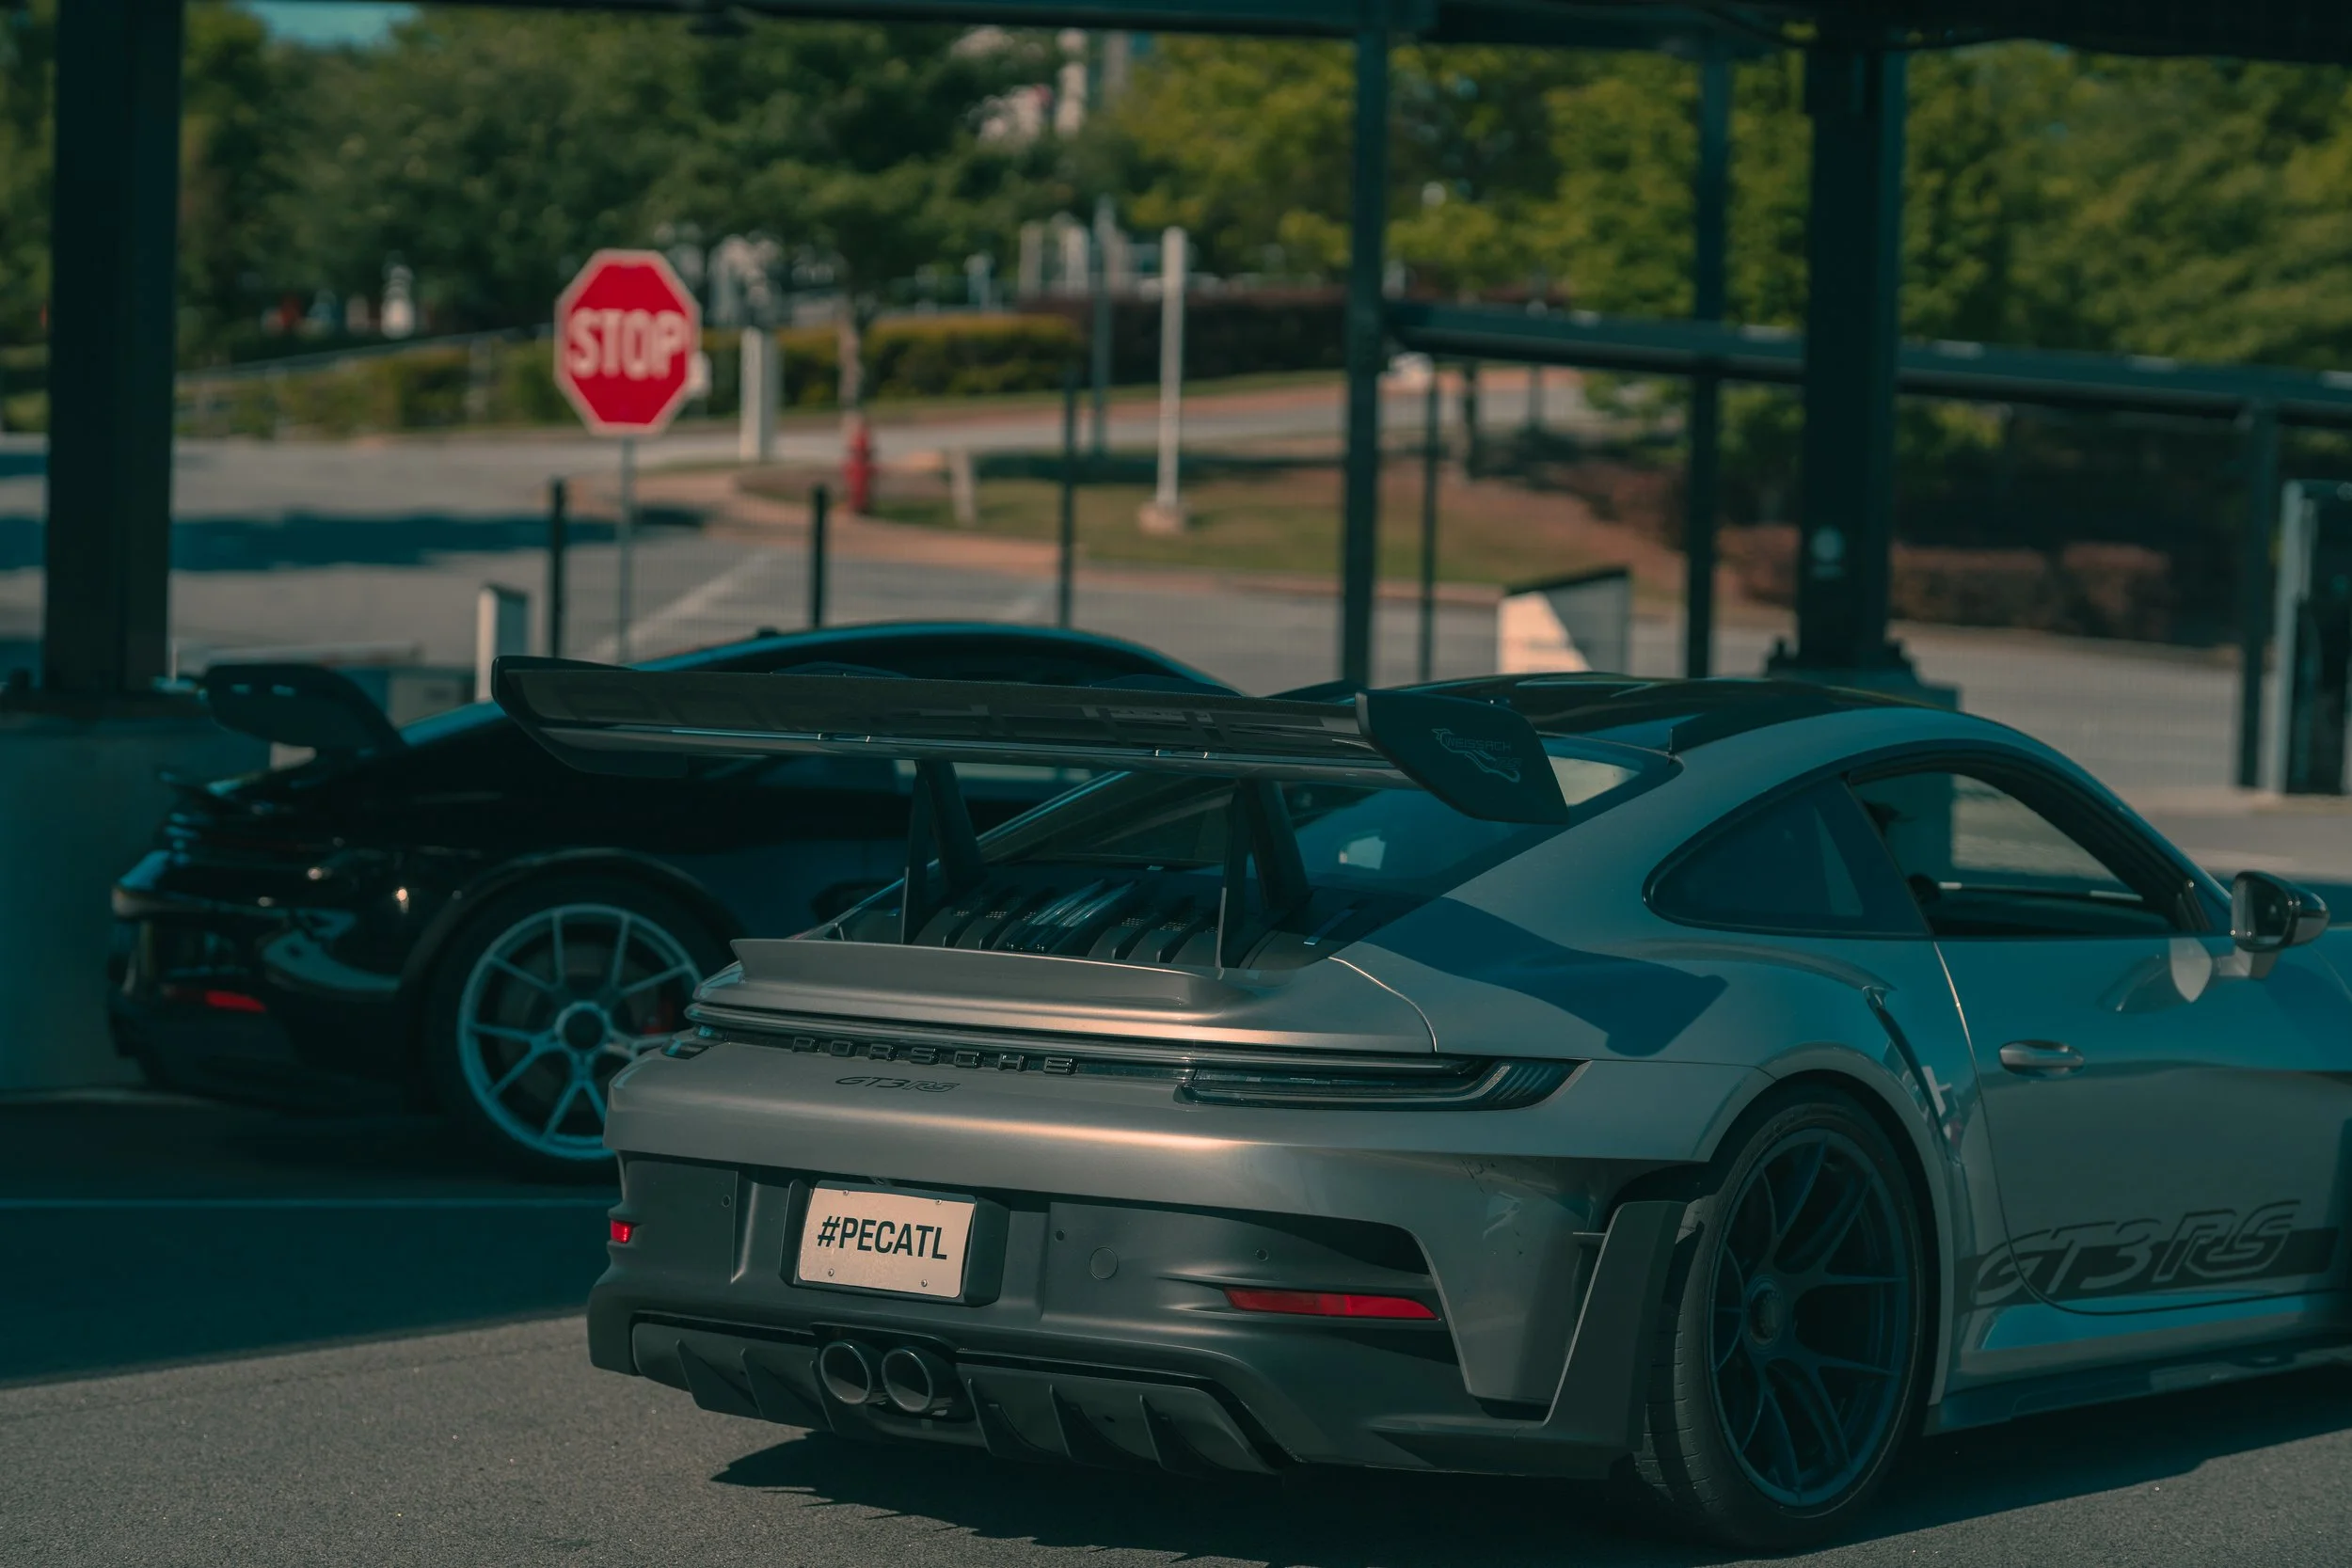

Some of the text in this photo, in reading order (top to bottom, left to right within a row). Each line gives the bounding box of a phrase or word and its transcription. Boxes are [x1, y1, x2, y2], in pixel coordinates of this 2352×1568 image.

[568, 308, 689, 381] STOP
[1444, 736, 1512, 752] WEISSACH
[792, 1036, 1079, 1075] PORSCHE
[817, 1215, 947, 1260] #PECATL
